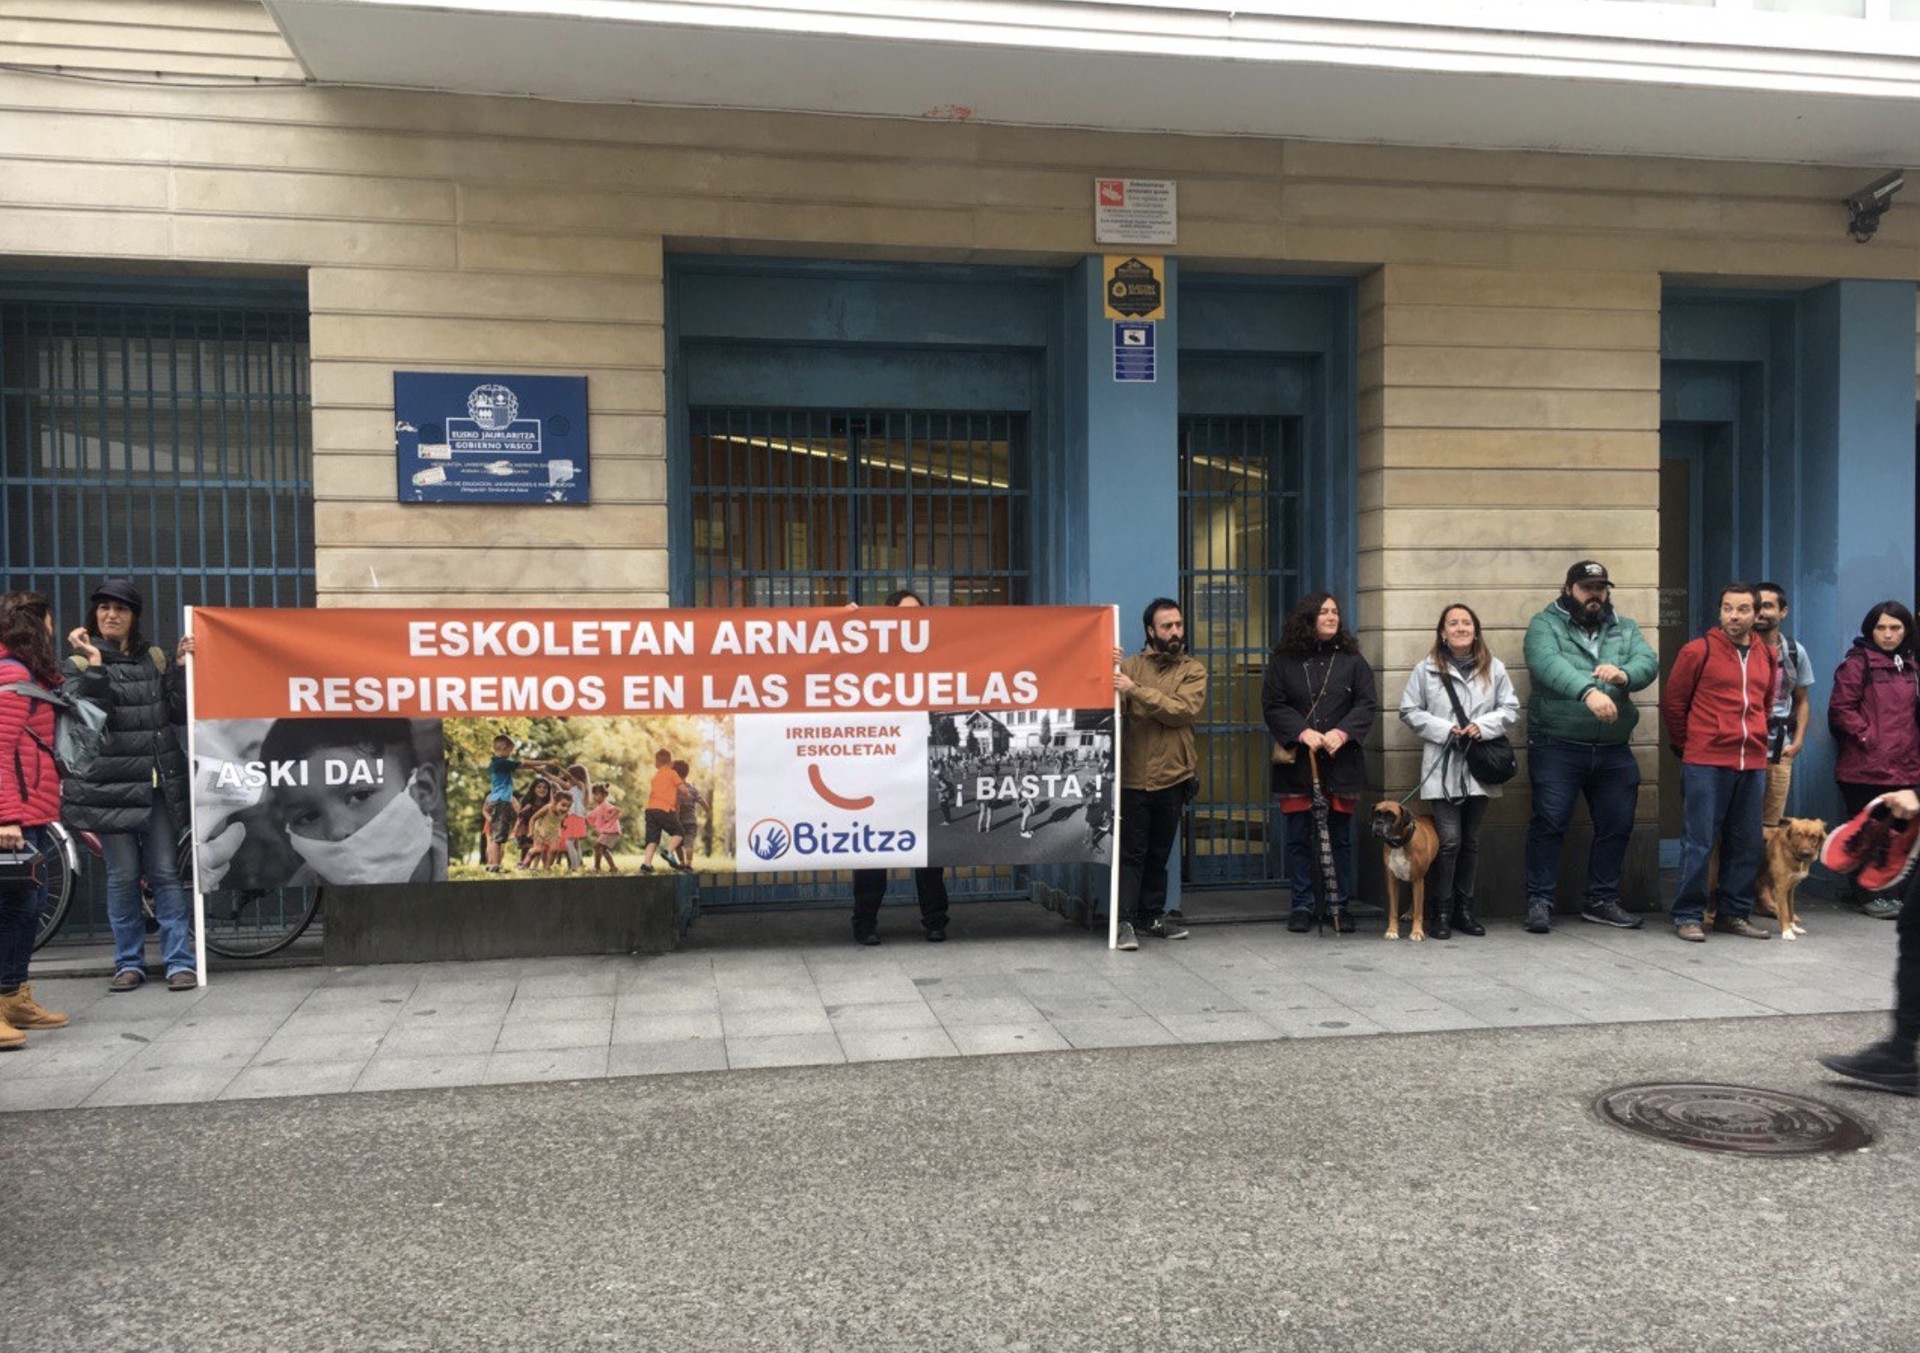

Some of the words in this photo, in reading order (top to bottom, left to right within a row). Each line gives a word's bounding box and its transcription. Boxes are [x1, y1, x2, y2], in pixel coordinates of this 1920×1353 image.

[451, 431, 479, 439] EUSKO
[481, 432, 536, 440] JAURLARITZA
[455, 442, 502, 450] GOBIERNO
[504, 443, 533, 451] VASCO
[408, 620, 695, 657] ESKOLETAN
[710, 619, 930, 655] ARNASTU
[288, 675, 607, 712] RESPIREMOS
[623, 675, 685, 711] EN
[702, 674, 789, 709] LAS
[805, 670, 1039, 708] ESCUELAS
[786, 725, 901, 739] IRRIBARREAK
[796, 743, 897, 757] ESKOLETAN
[216, 759, 309, 788] ASKI
[325, 757, 385, 786] DA!
[976, 774, 1083, 801] BASTA
